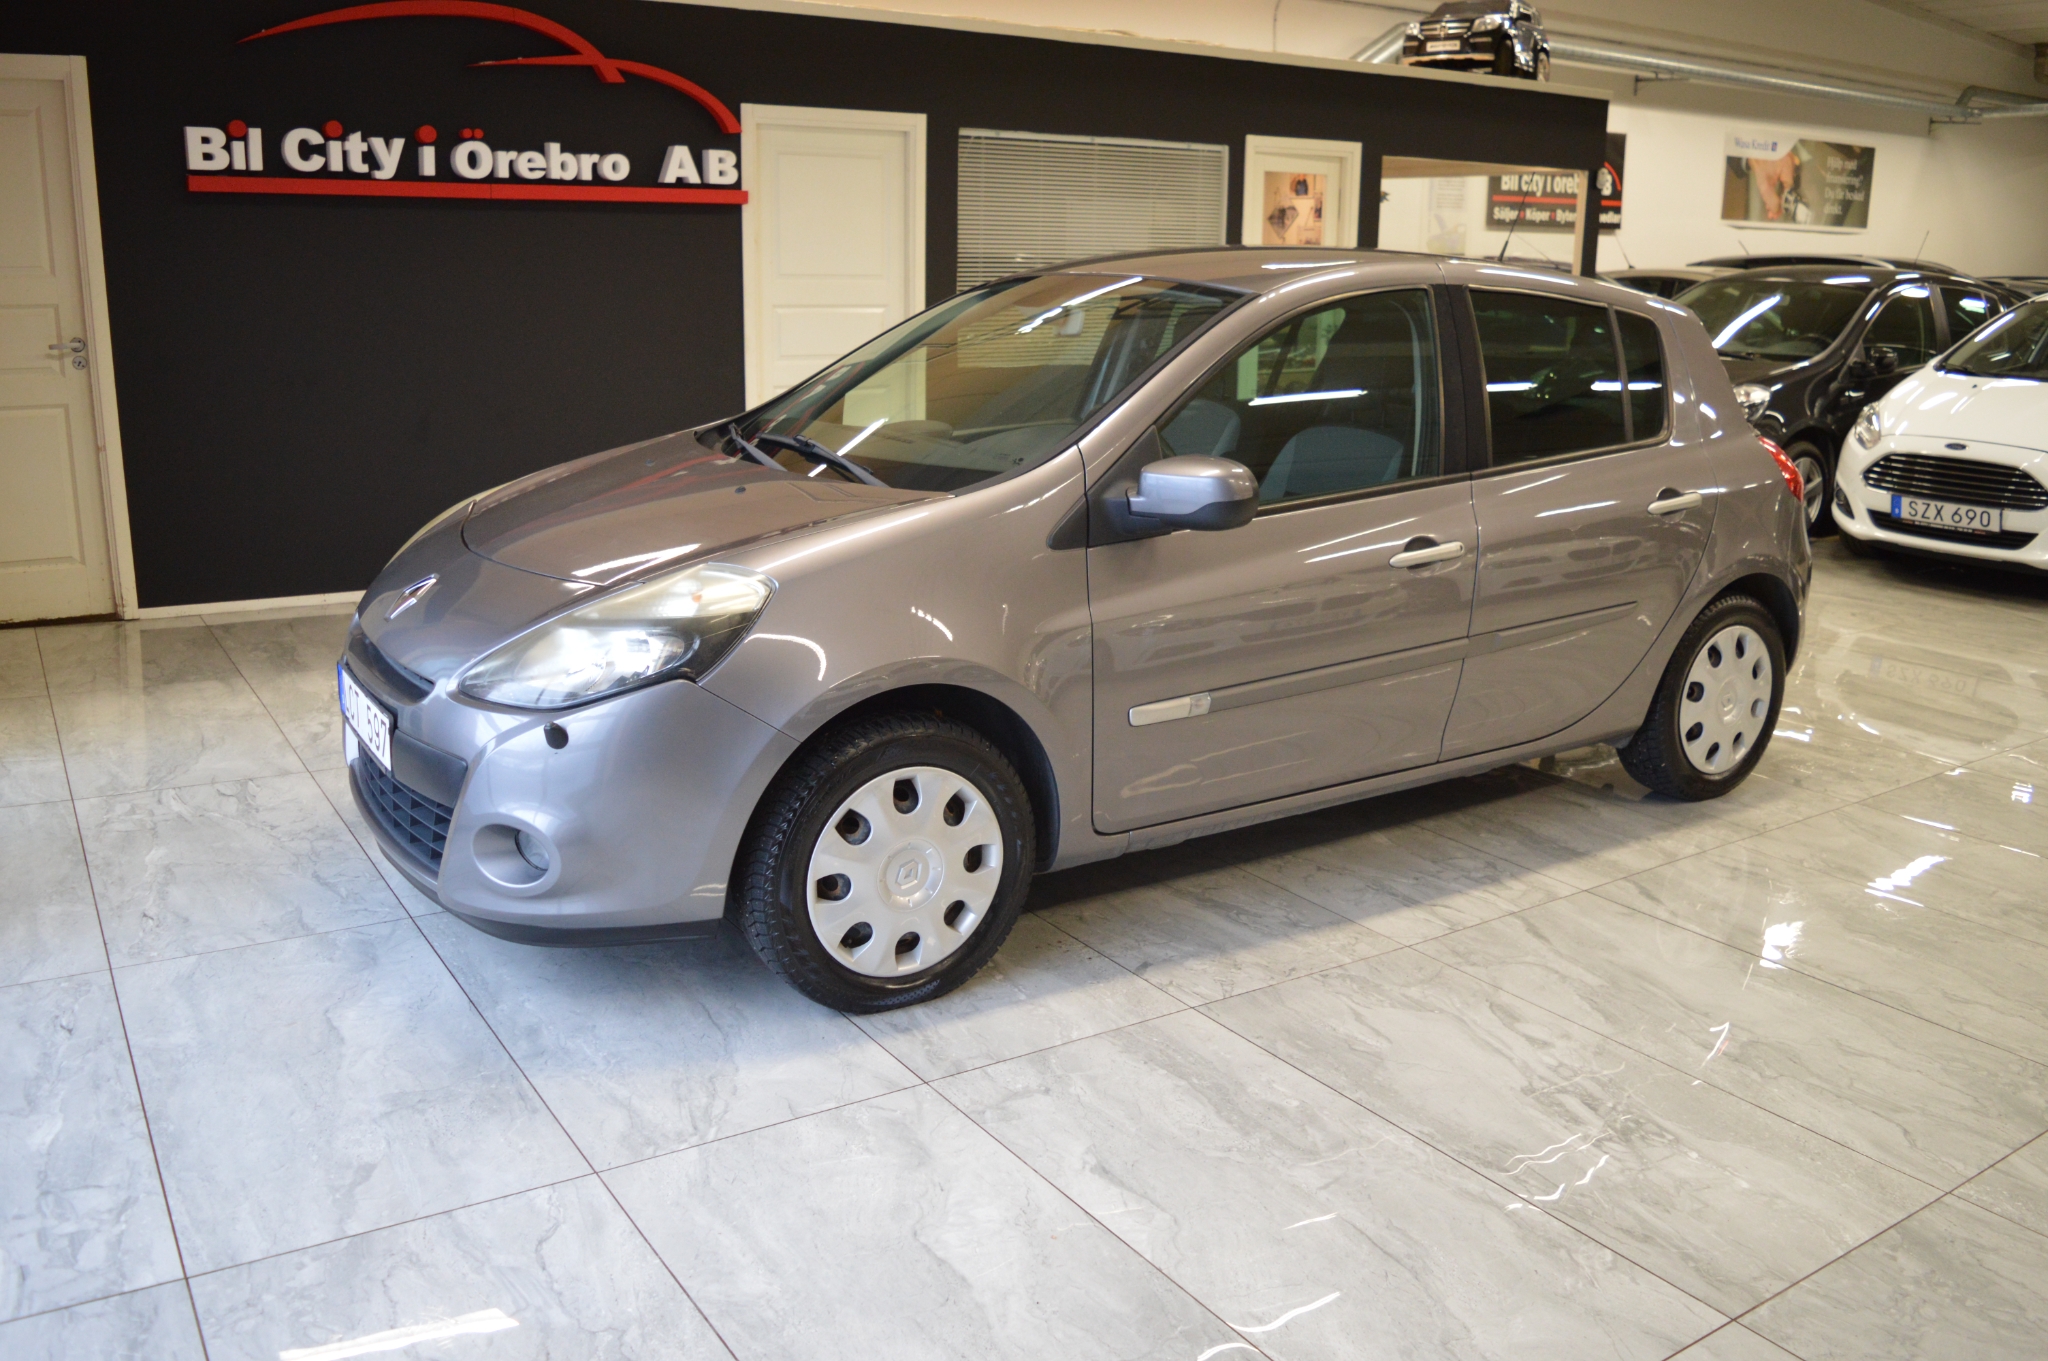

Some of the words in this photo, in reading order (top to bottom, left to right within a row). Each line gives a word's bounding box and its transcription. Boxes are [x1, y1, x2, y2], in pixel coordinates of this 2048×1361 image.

[183, 119, 263, 172] Bil
[281, 119, 405, 180] City
[415, 124, 437, 177] i
[450, 127, 631, 181] Örebro
[657, 144, 739, 185] AB
[1908, 500, 1945, 522] SZX
[1951, 507, 1991, 528] 690
[366, 703, 388, 758] 597
